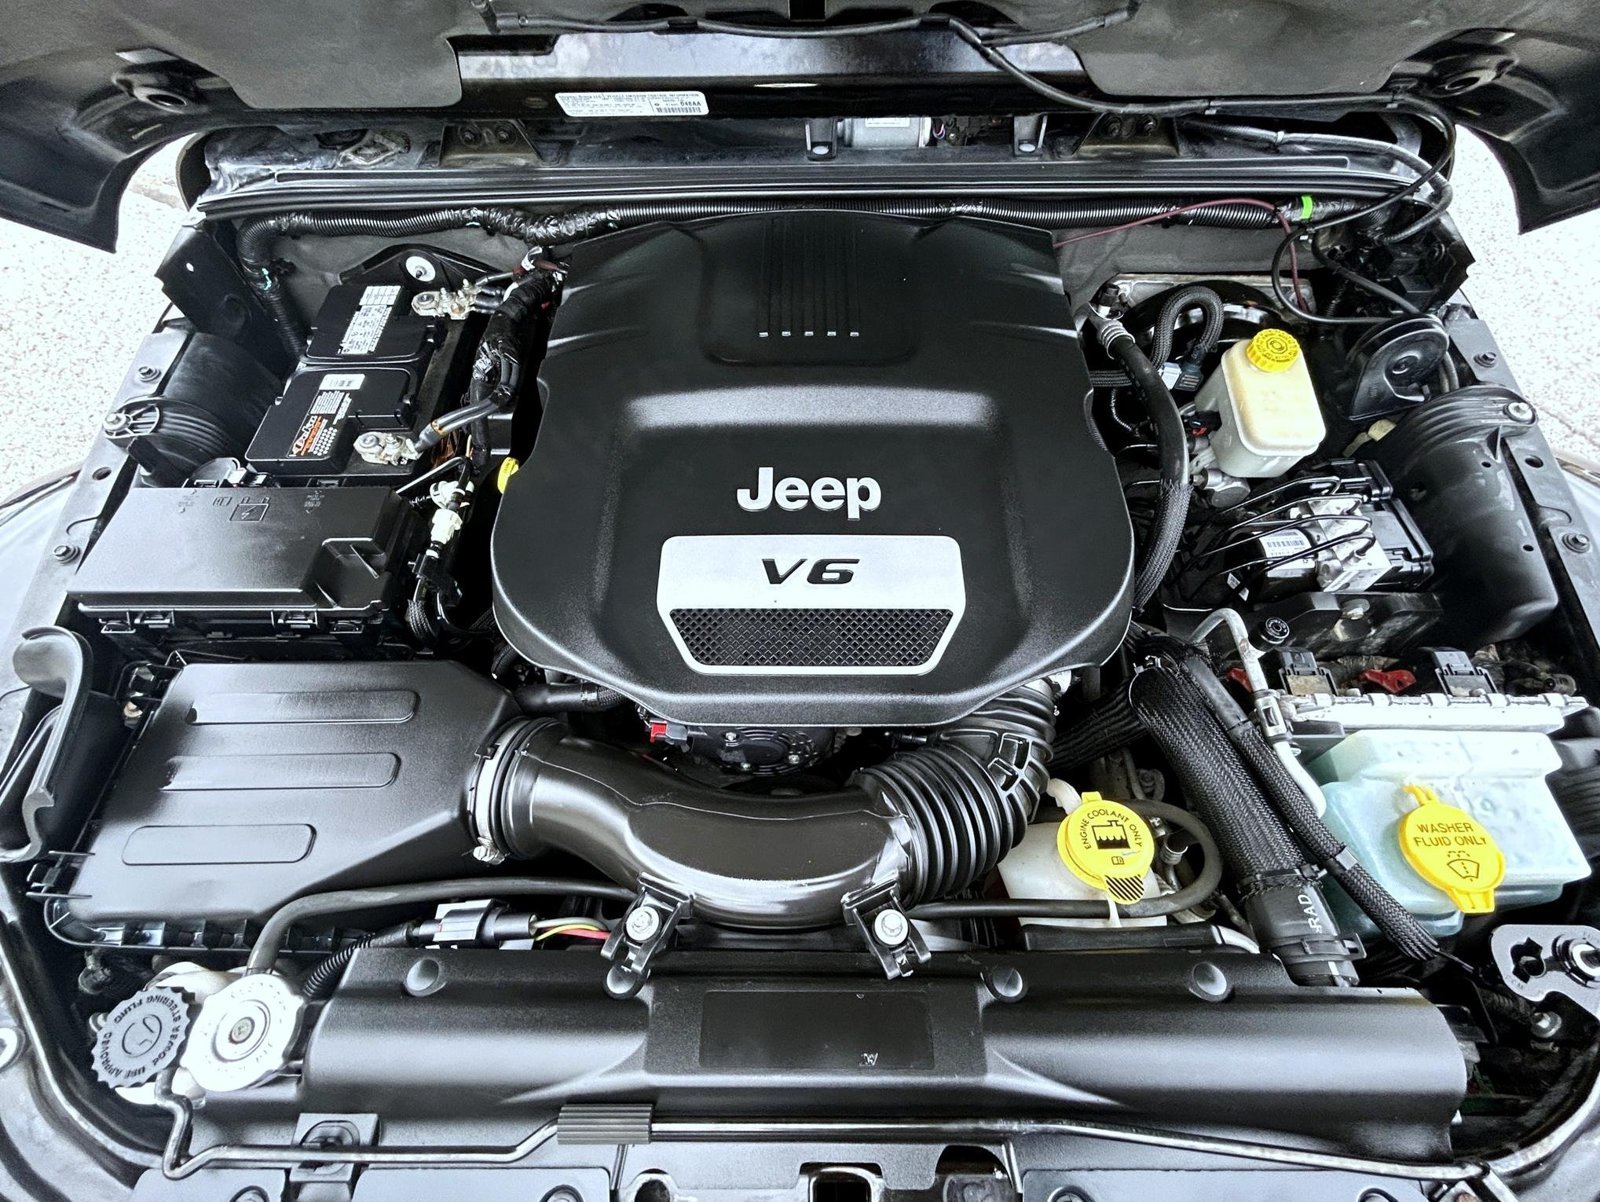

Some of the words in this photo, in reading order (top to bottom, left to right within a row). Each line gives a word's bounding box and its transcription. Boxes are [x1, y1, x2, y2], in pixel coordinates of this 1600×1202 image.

[736, 466, 882, 521] Jeep
[761, 558, 861, 585] V6
[1080, 818, 1092, 850] ENGINE
[1087, 808, 1130, 823] COOLANT
[1129, 823, 1143, 848] ONLY
[1413, 836, 1452, 847] FLUID
[1454, 835, 1487, 847] ONLY
[1416, 822, 1474, 834] WASHER
[113, 998, 144, 1024] FLUID
[146, 995, 182, 1022] STEERING
[100, 1031, 123, 1078] APPROVED
[152, 1024, 181, 1066] POWER
